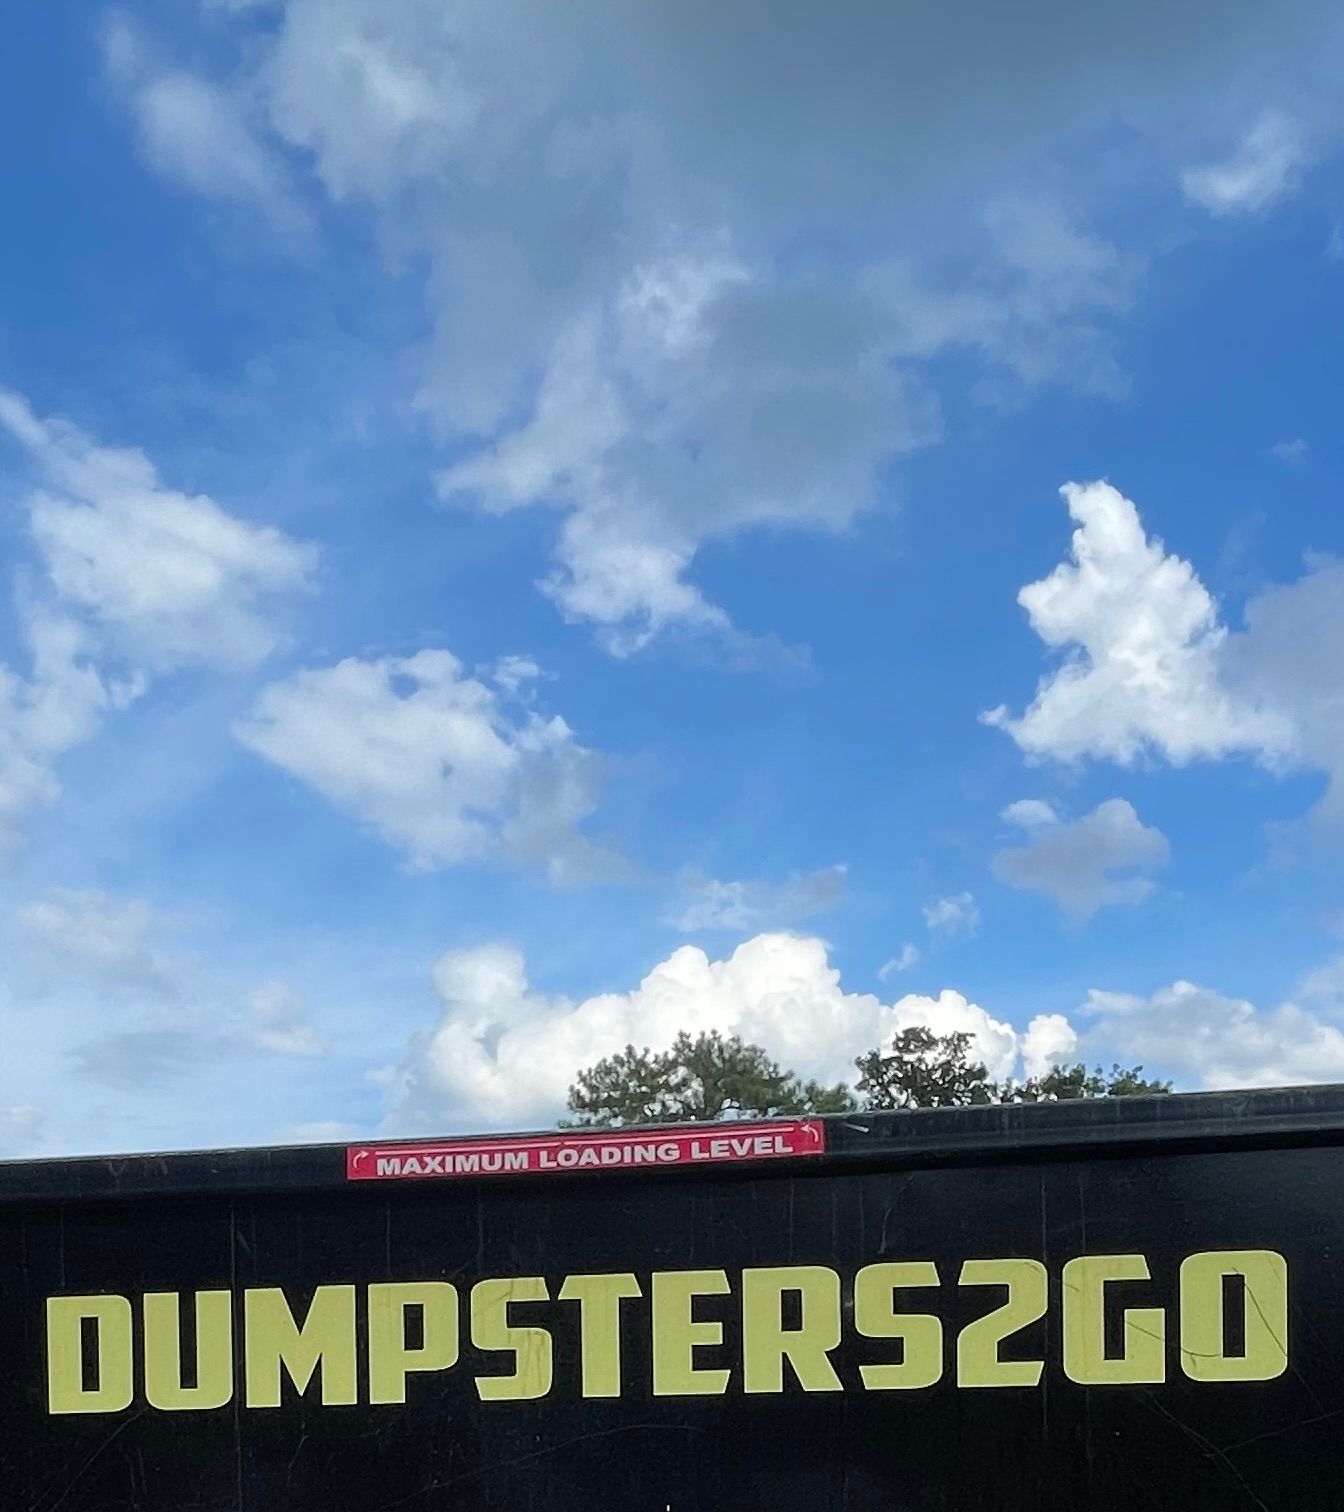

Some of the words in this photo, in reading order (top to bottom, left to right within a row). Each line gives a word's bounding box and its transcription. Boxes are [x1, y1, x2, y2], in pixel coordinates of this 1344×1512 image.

[376, 1151, 529, 1177] MAXIMUM
[539, 1143, 680, 1169] LOADING
[691, 1135, 794, 1160] LEVEL
[46, 1249, 1288, 1415] DUMPSTERS2GO
